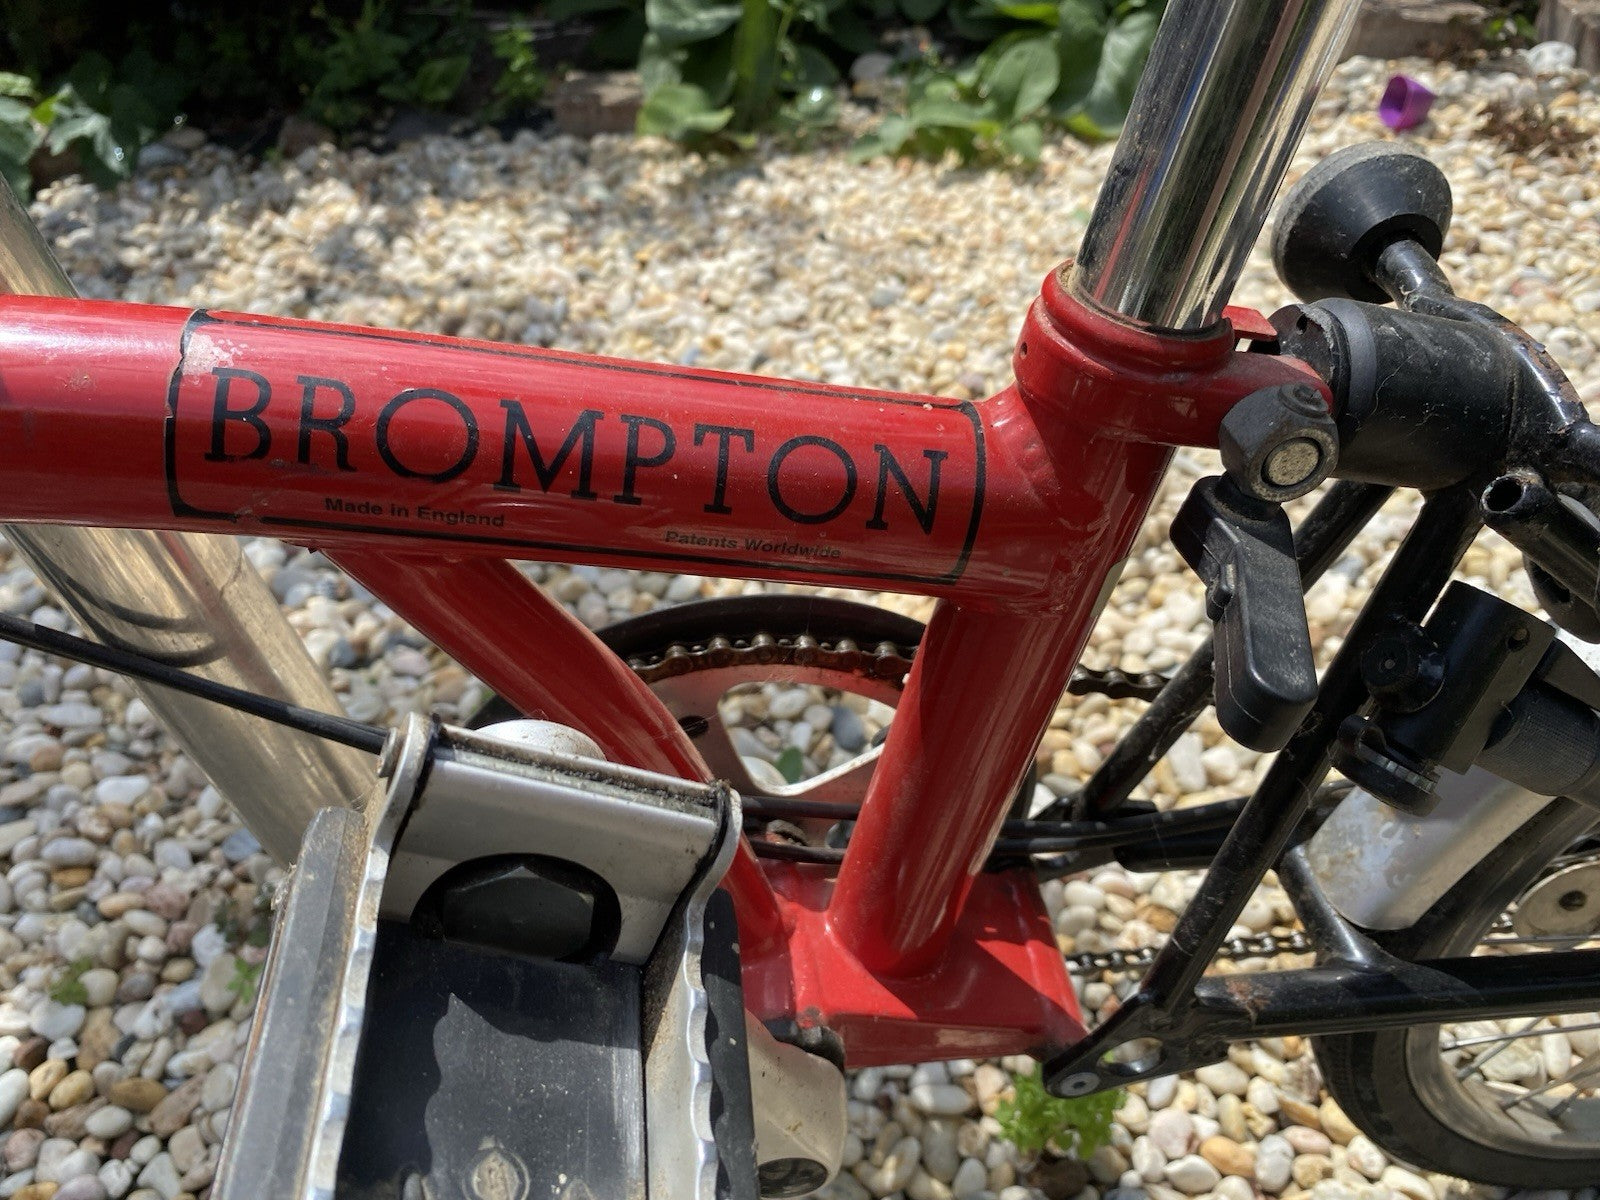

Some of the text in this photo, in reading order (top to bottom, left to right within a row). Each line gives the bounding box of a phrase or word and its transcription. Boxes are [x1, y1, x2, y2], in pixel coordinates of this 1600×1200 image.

[204, 366, 949, 536] BROMPTON
[325, 497, 505, 528] Made in England
[665, 530, 842, 559] Patents Worldwide
